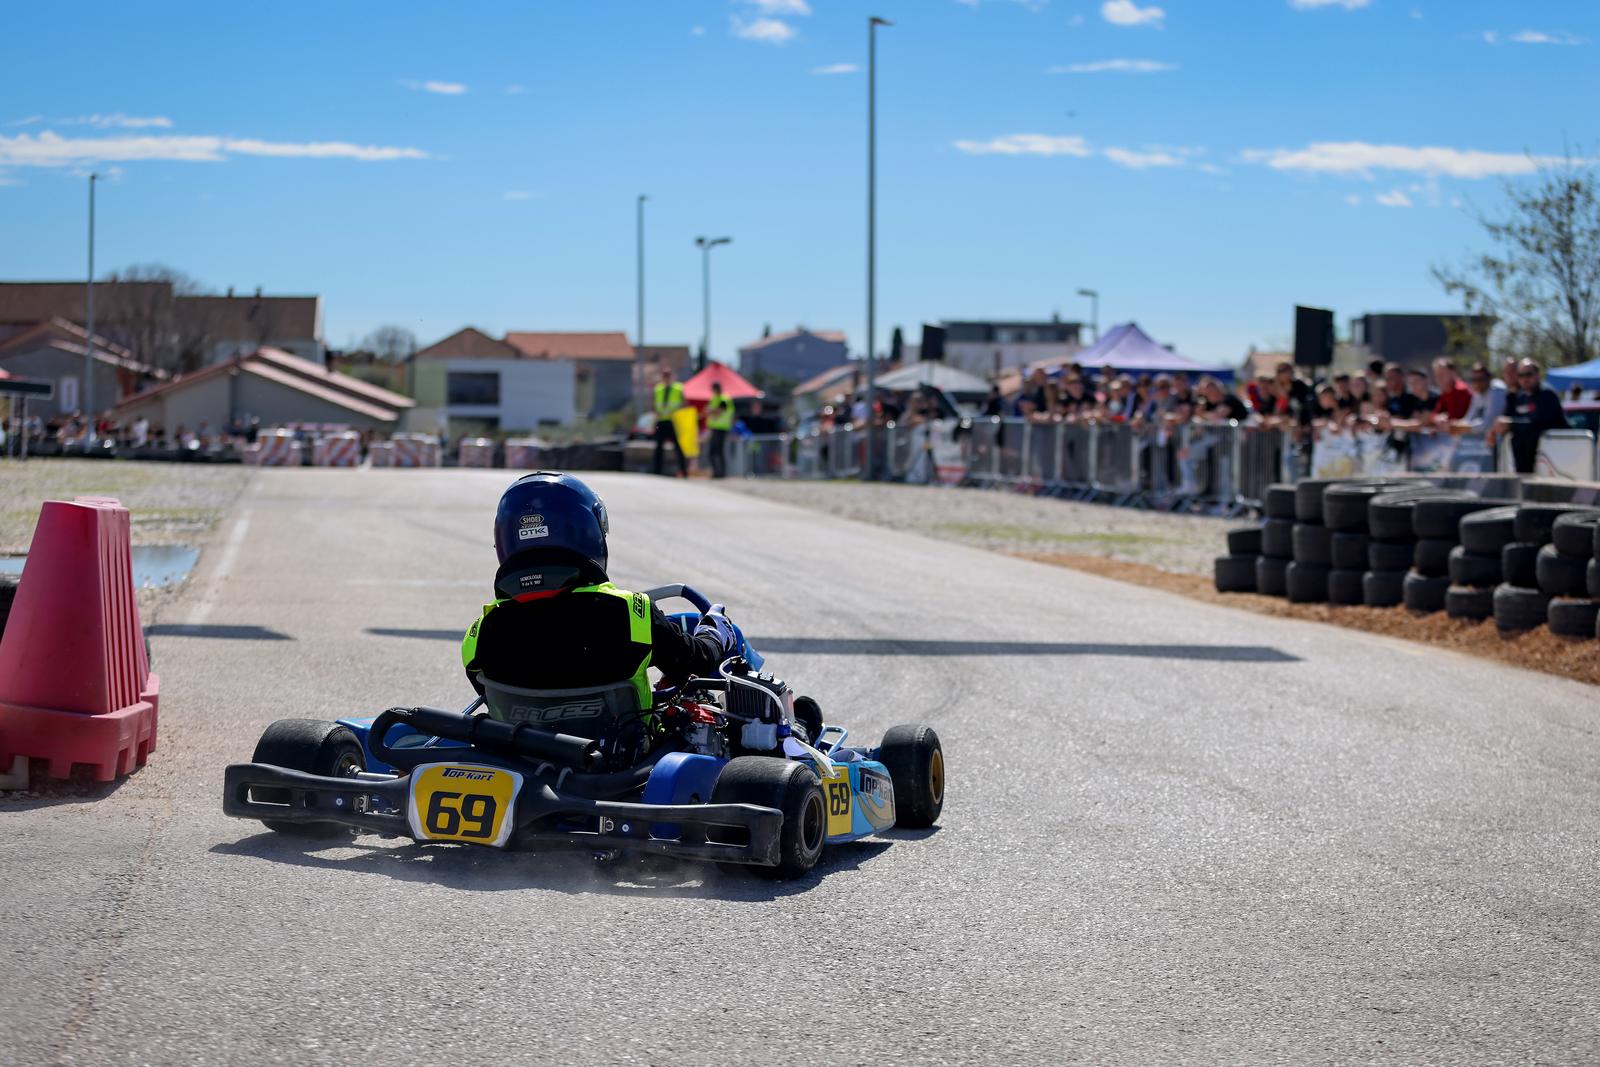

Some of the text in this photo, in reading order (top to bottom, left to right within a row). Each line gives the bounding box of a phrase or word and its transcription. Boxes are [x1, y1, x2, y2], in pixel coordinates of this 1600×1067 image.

[522, 516, 541, 524] SHOEI
[426, 791, 497, 838] 69
[829, 783, 850, 816] 69
